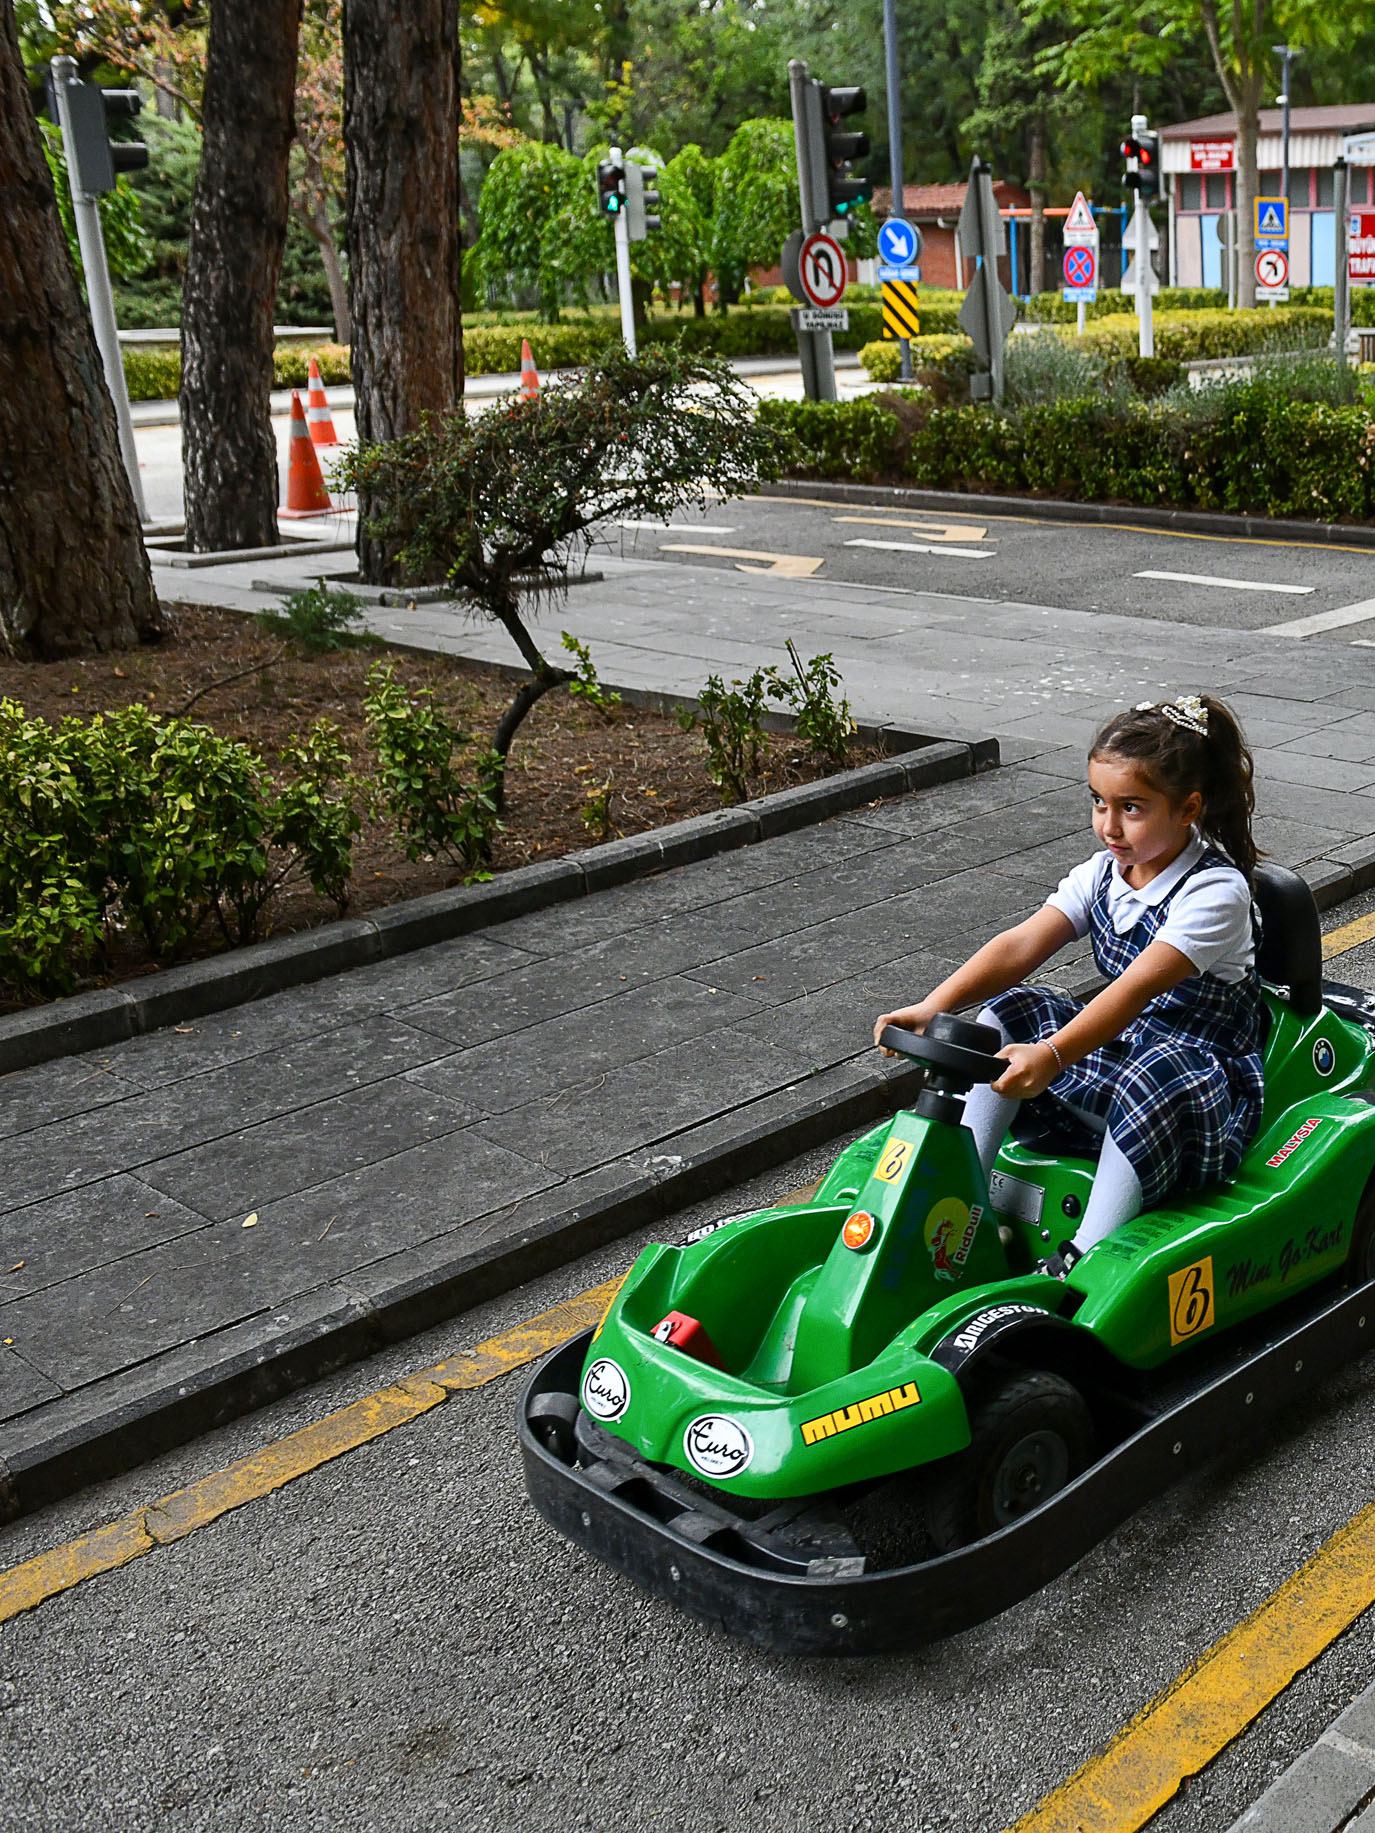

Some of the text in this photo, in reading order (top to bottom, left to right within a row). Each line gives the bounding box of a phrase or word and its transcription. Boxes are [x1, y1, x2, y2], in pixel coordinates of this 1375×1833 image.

[879, 1143, 906, 1180] 6
[1266, 1119, 1323, 1168] MALYSIA
[954, 1204, 983, 1264] RidDull
[1226, 1257, 1273, 1297] Mini
[1174, 1267, 1209, 1336] 6
[589, 1366, 625, 1406] Euro
[693, 1422, 745, 1460] Euro
